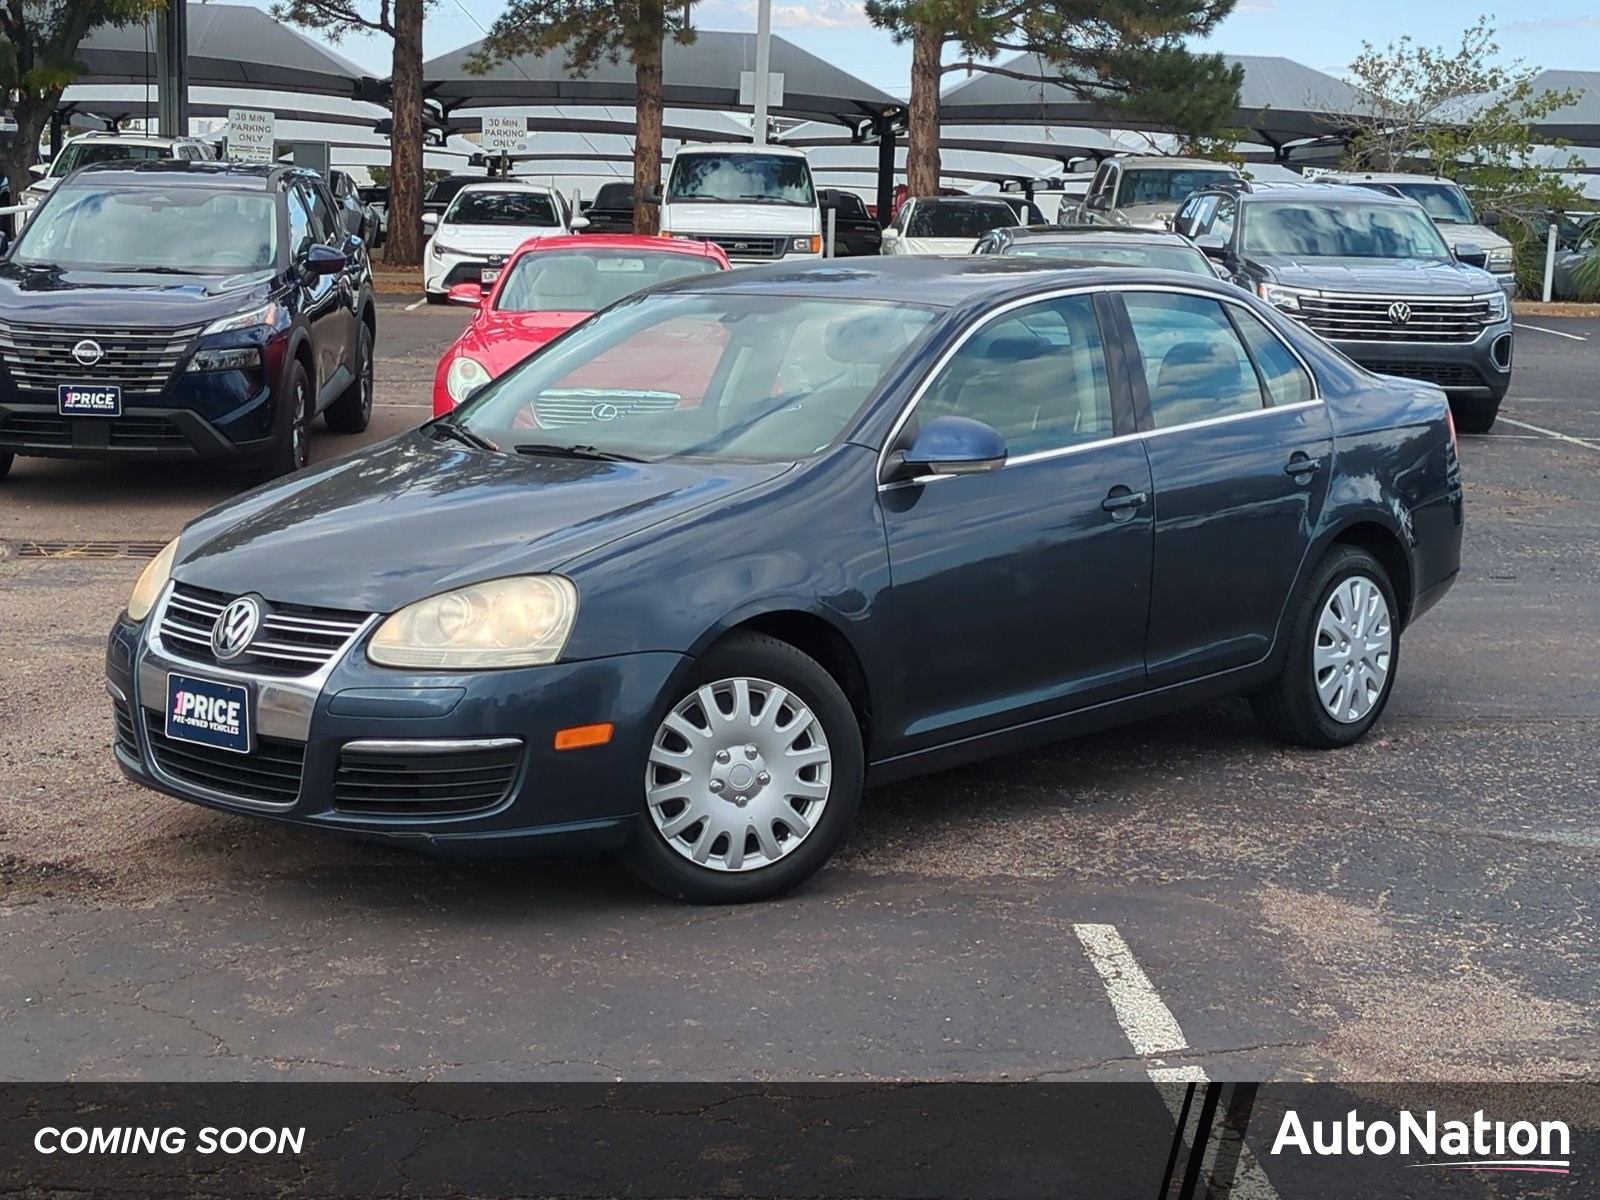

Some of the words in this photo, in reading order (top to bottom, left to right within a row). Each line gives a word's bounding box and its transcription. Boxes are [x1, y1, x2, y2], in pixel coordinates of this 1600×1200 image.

[235, 112, 246, 121] 30
[249, 114, 266, 122] MIN
[488, 119, 499, 127] 30
[230, 123, 272, 133] PARKING
[238, 133, 264, 142] ONLY
[485, 129, 524, 137] PARKING
[493, 139, 517, 147] ONLY
[172, 714, 209, 729] PRE-OWNED
[209, 721, 240, 735] VEHICLES
